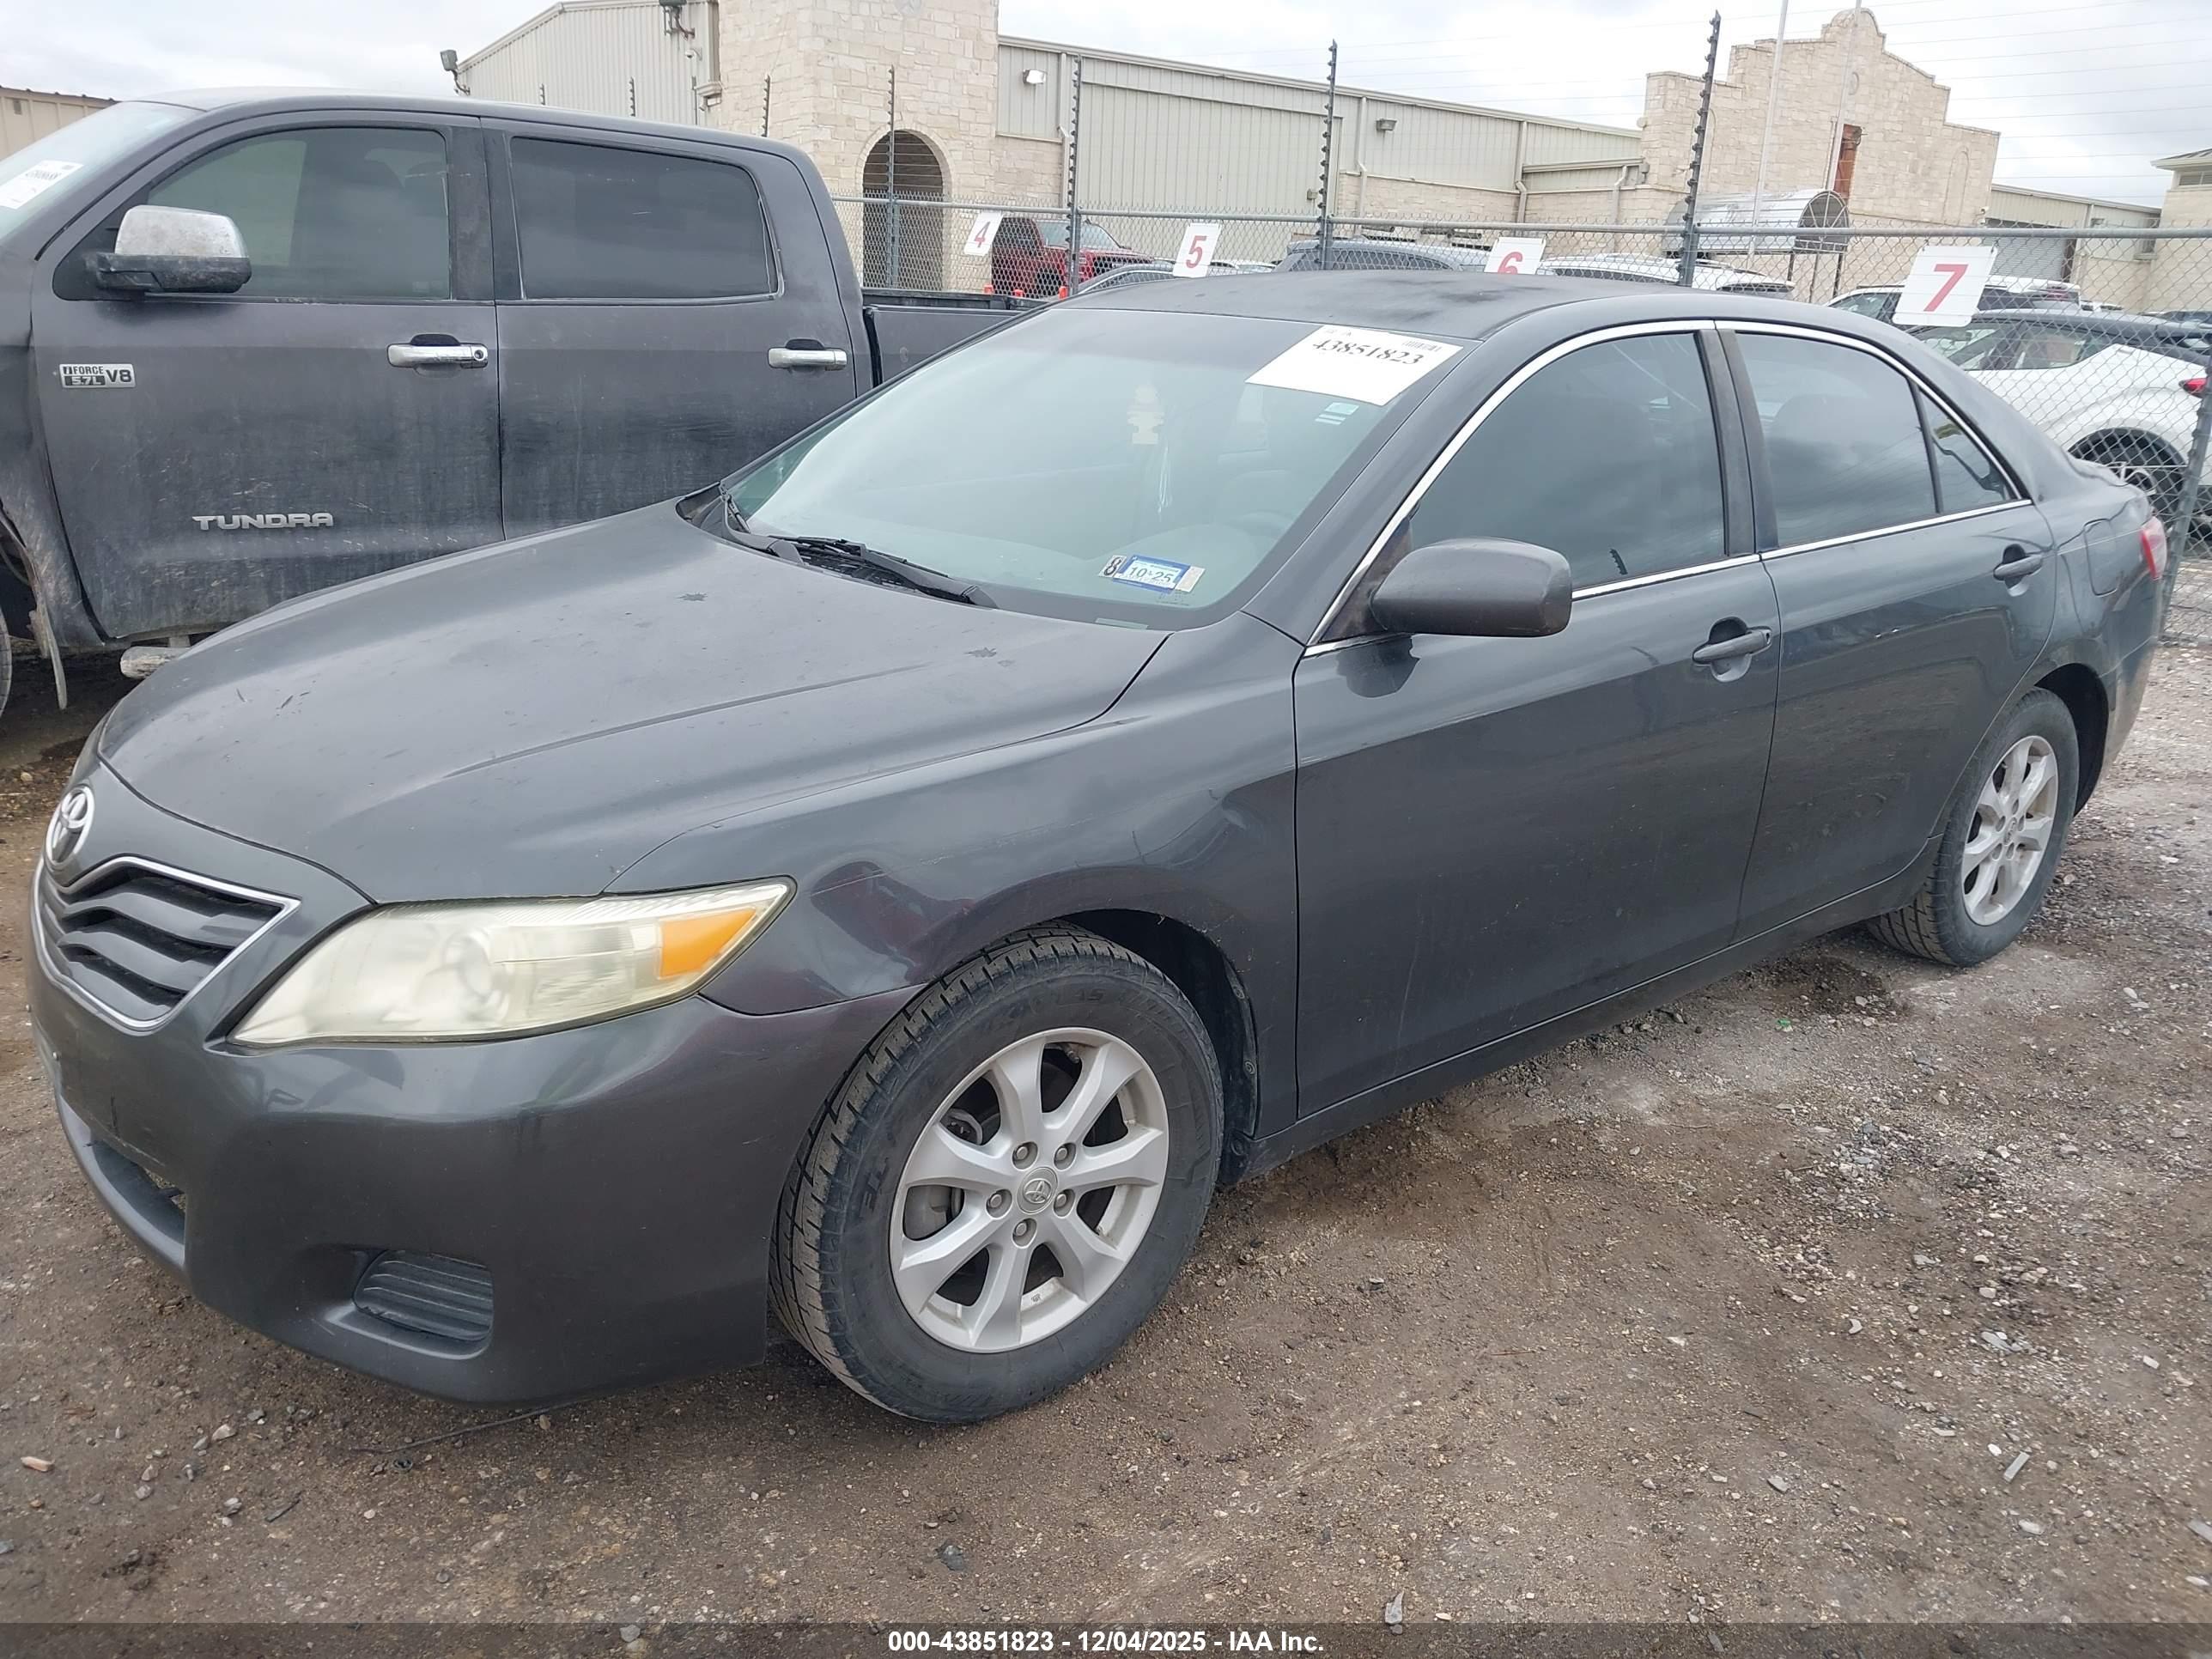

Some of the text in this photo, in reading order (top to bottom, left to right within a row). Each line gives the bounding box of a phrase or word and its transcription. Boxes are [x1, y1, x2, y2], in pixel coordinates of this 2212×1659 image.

[974, 221, 990, 248] 4
[1185, 234, 1207, 269] 5
[1497, 251, 1524, 275] 6
[1923, 264, 1969, 313] 7
[1312, 339, 1425, 365] 43851823
[71, 376, 102, 386] 5.7L
[105, 369, 132, 383] V8
[191, 513, 334, 531] TUNDRA
[1103, 556, 1122, 576] 8
